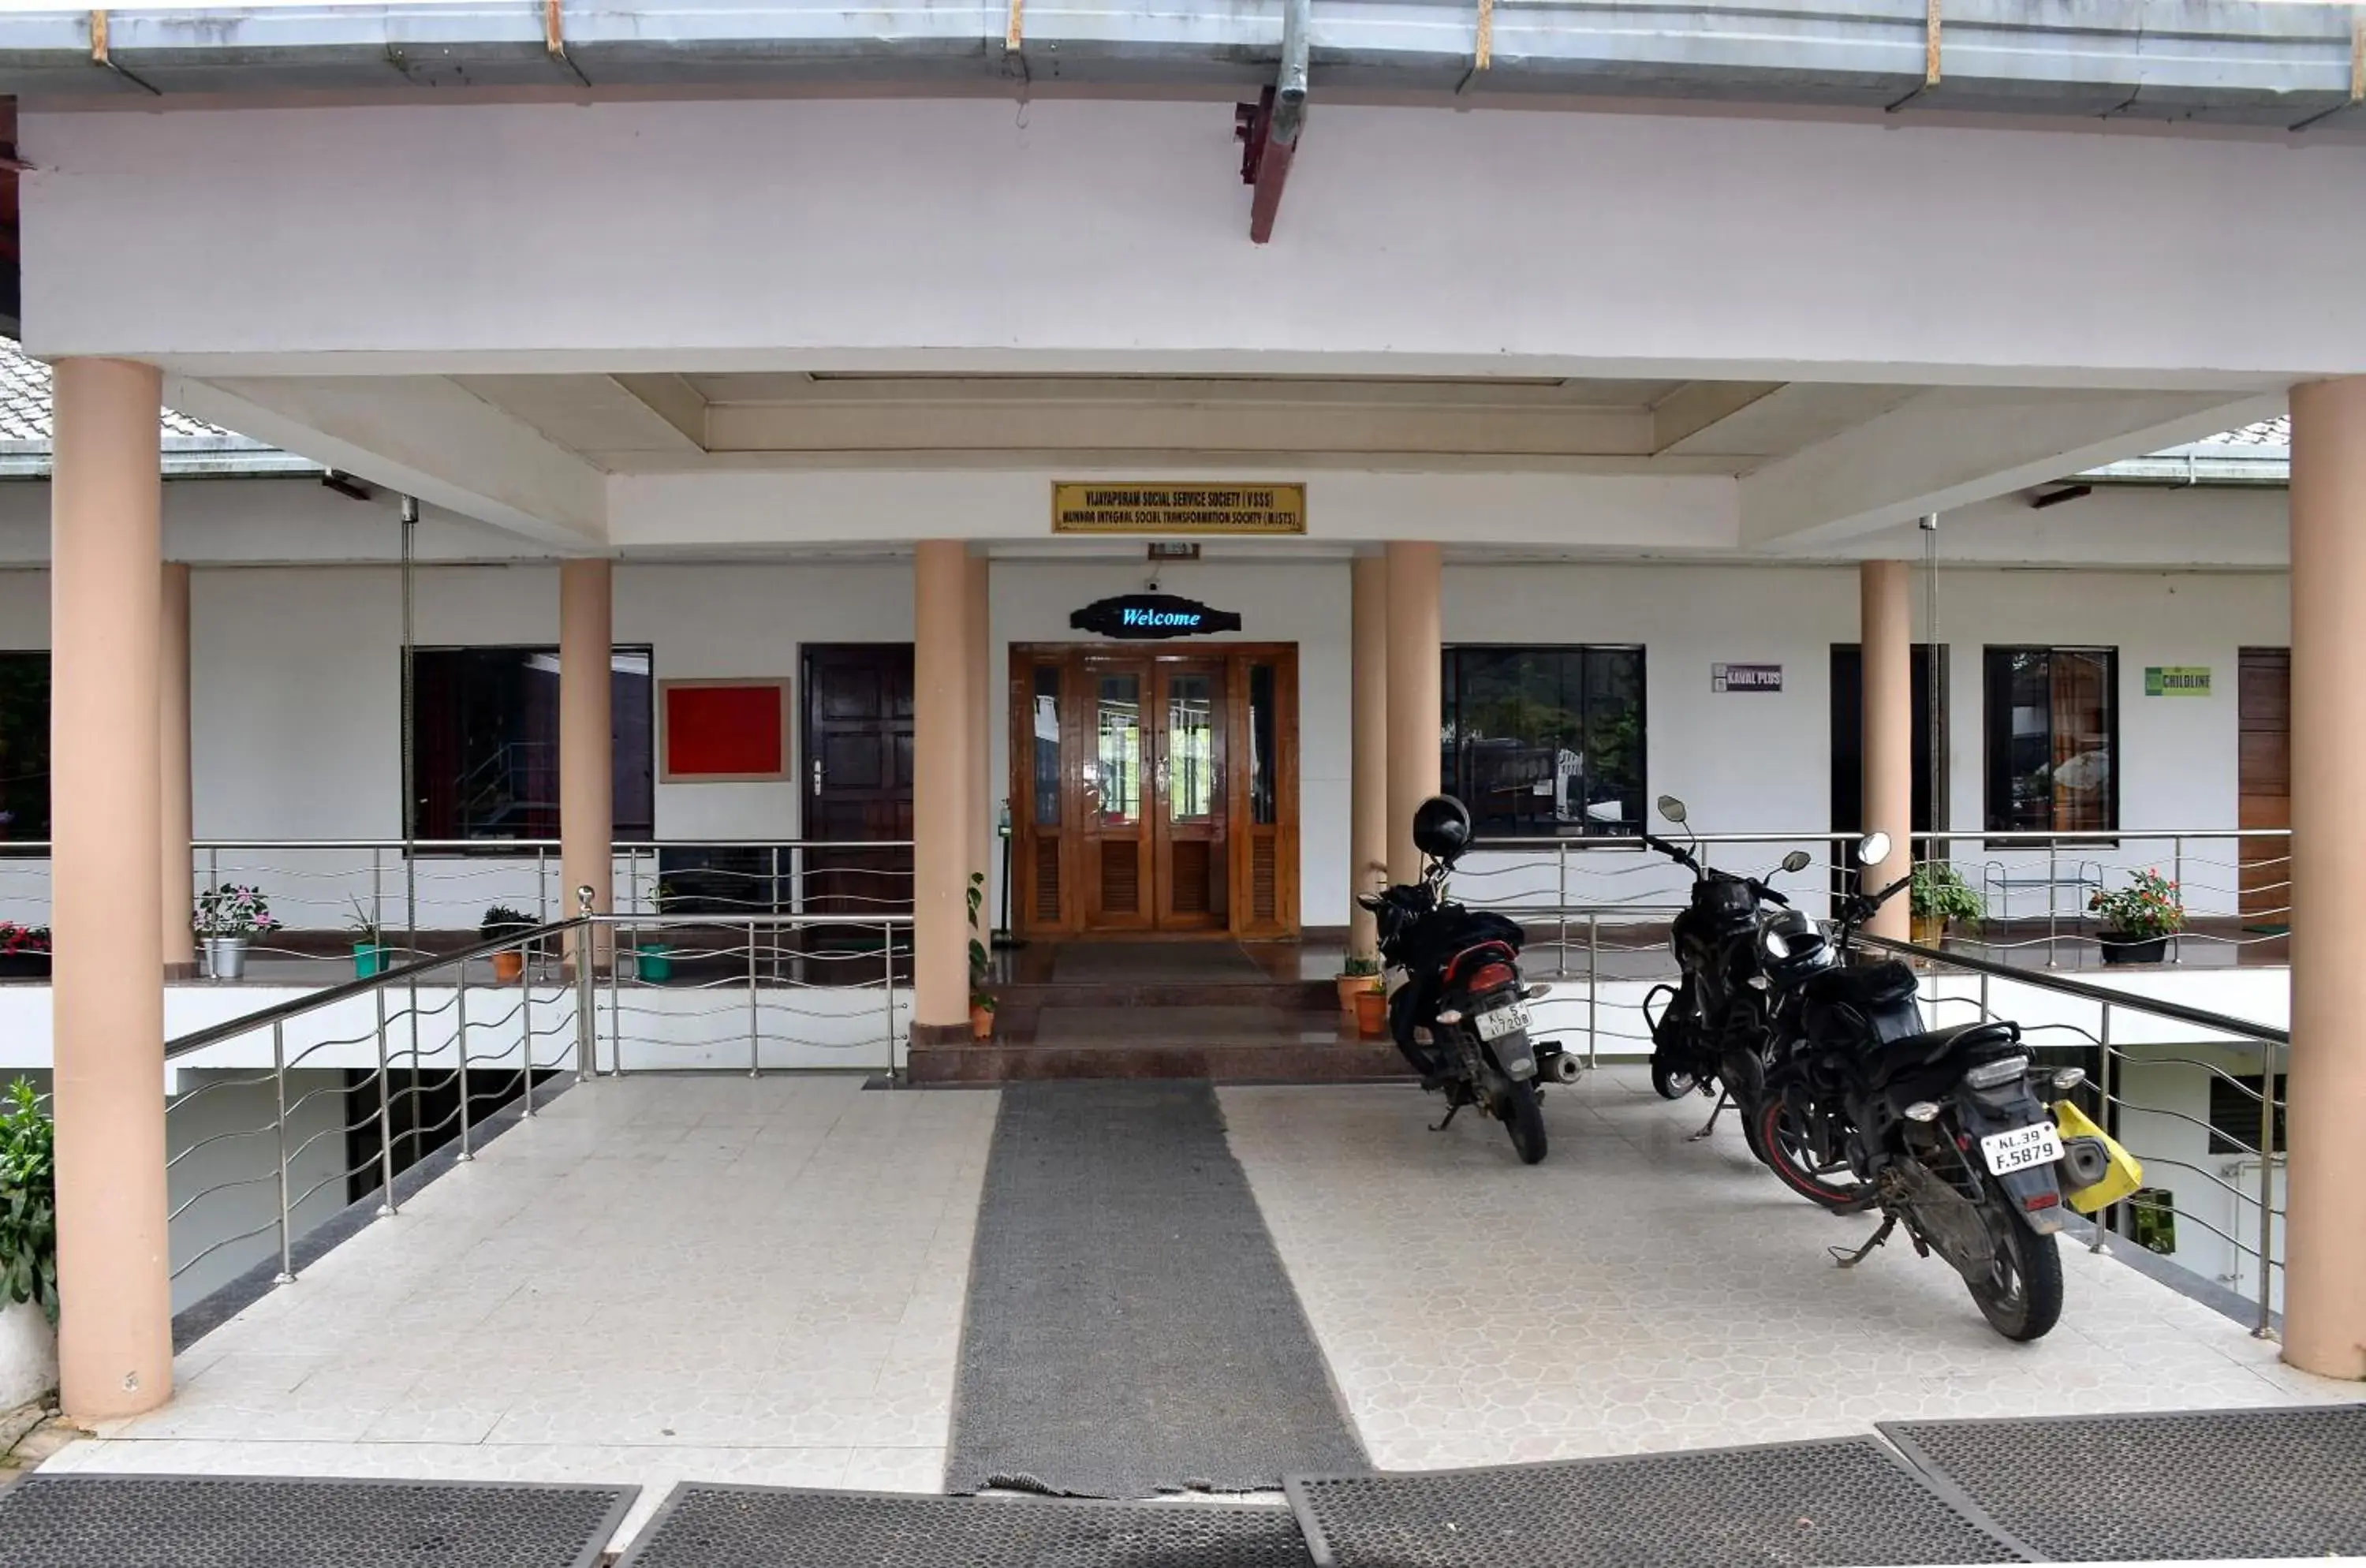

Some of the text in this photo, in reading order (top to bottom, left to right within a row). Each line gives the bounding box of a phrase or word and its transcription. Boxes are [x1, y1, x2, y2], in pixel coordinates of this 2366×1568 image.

[1085, 491, 1140, 506] VIJAYAPURAM
[1143, 491, 1170, 506] SOCIAL
[1173, 491, 1206, 507] SERVICE
[1207, 491, 1241, 507] SOCIETY
[1062, 510, 1095, 524] MUNNAR
[1097, 510, 1133, 524] INTEGRAL
[1135, 511, 1162, 524] SOCIAL
[1163, 511, 1230, 524] TRANSFORMATION
[1232, 512, 1262, 524] SOCIETY
[1123, 609, 1200, 625] Welcome
[1727, 670, 1781, 685] KAVAL PLUS
[2163, 674, 2211, 689] CHILDLINE
